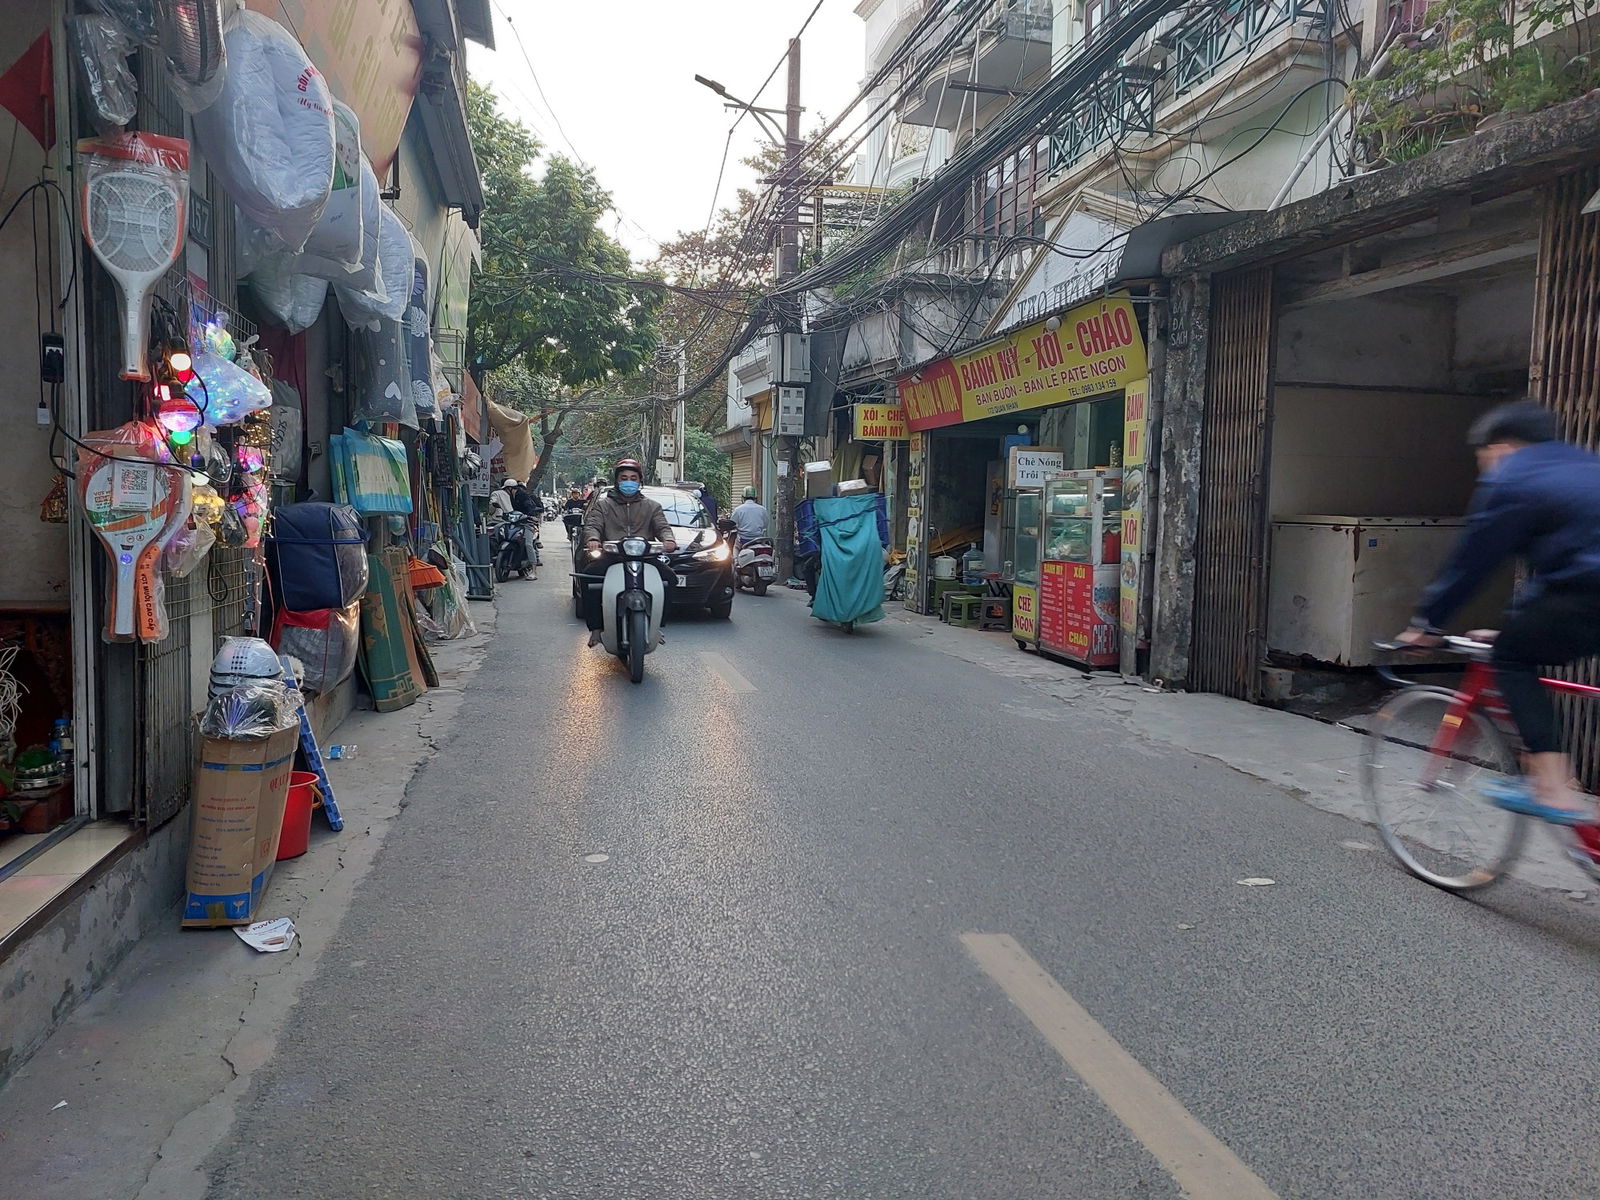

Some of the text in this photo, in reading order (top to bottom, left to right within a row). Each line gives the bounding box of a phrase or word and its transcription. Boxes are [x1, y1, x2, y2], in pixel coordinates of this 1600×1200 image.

[961, 354, 998, 391] BÁNH
[1031, 327, 1064, 370] XÔI
[1076, 304, 1133, 357] CHÁO
[975, 389, 992, 405] BÁN
[993, 383, 1017, 401] BUÔN
[1023, 376, 1044, 394] BÁN
[1060, 366, 1088, 385] PATE
[1090, 355, 1127, 378] NGON
[863, 407, 878, 421] XÔI
[862, 423, 887, 437] BÁNH
[1018, 456, 1062, 469] Chè Nóng
[1019, 470, 1039, 479] Trôi
[1123, 513, 1137, 545] XÔI
[1073, 565, 1086, 579] XÔI
[145, 603, 153, 617] CAO
[1018, 593, 1032, 613] CHÈ
[1014, 614, 1034, 633] NGON
[1068, 631, 1088, 646] CHÁO
